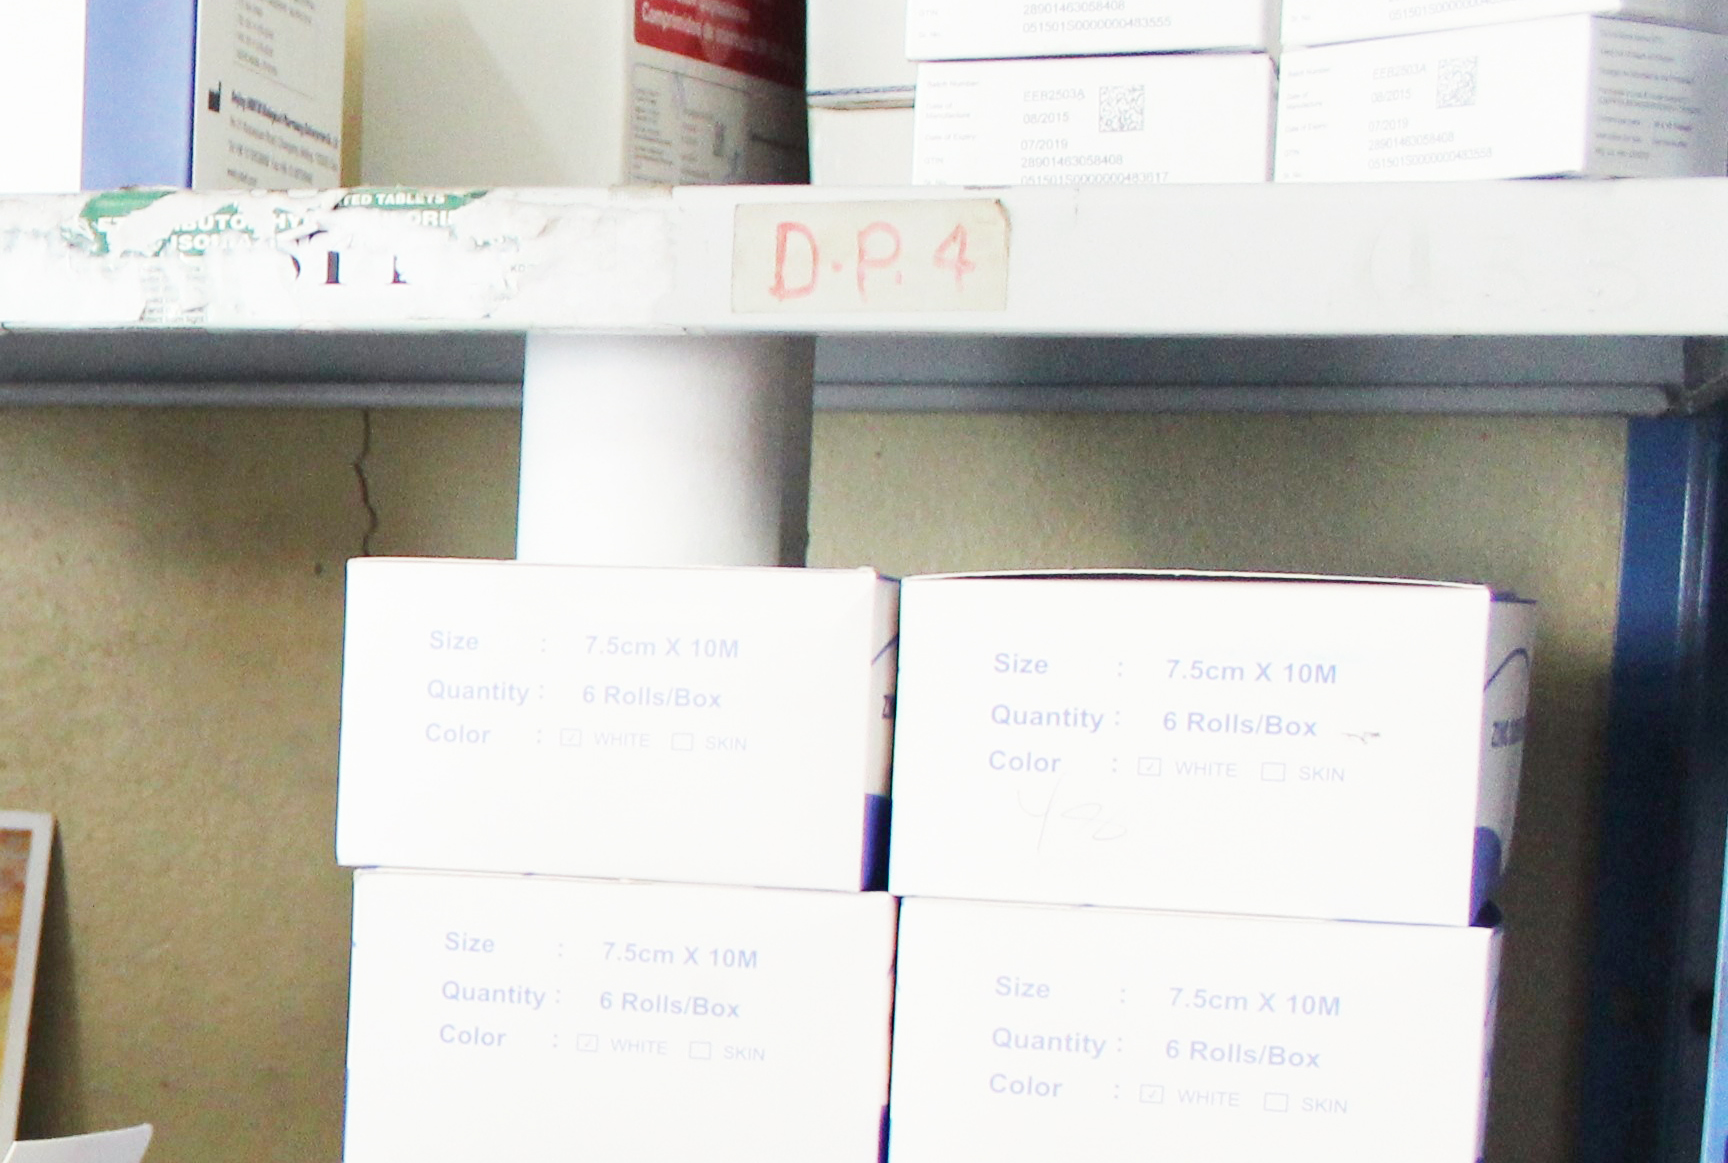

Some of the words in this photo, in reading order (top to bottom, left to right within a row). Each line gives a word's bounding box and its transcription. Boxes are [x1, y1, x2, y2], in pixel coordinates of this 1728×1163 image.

[933, 222, 976, 292] 4
[430, 630, 479, 650] Size
[586, 635, 656, 656] 7.5cm
[666, 638, 680, 656] X
[693, 639, 739, 658] 10M
[994, 653, 1049, 674] Size
[1168, 659, 1244, 681] 7.5cm
[1255, 663, 1271, 681] X
[1285, 663, 1337, 683] 10M
[427, 679, 529, 706] Quantity
[583, 685, 595, 703] 6
[604, 685, 721, 708] Rolls/Box
[425, 722, 491, 744] Color
[595, 733, 649, 748] WHITE
[706, 736, 747, 751] SKIN
[991, 704, 1104, 733] Quantity
[1163, 711, 1177, 731] 6
[1187, 712, 1317, 736] Rolls/Box
[989, 750, 1061, 772] Color
[1175, 761, 1236, 777] WHITE
[1299, 766, 1345, 782] SKIN
[445, 932, 495, 953] Size
[604, 942, 674, 964] 7.5cm
[684, 947, 698, 965] X
[711, 949, 758, 968] 10M
[442, 981, 546, 1010] Quantity
[600, 991, 613, 1009] 6
[622, 992, 739, 1018] Rolls/Box
[995, 976, 1050, 998] Size
[1170, 987, 1248, 1010] 7.5cm
[1259, 993, 1275, 1012] X
[1288, 995, 1341, 1016] 10M
[439, 1024, 506, 1046] Color
[611, 1039, 666, 1055] WHITE
[724, 1046, 765, 1061] SKIN
[992, 1027, 1106, 1059] Quantity
[1166, 1039, 1180, 1059] 6
[1190, 1041, 1320, 1068] Rolls/Box
[989, 1073, 1063, 1097] Color
[1178, 1089, 1239, 1107] WHITE
[1302, 1097, 1348, 1114] SKIN
